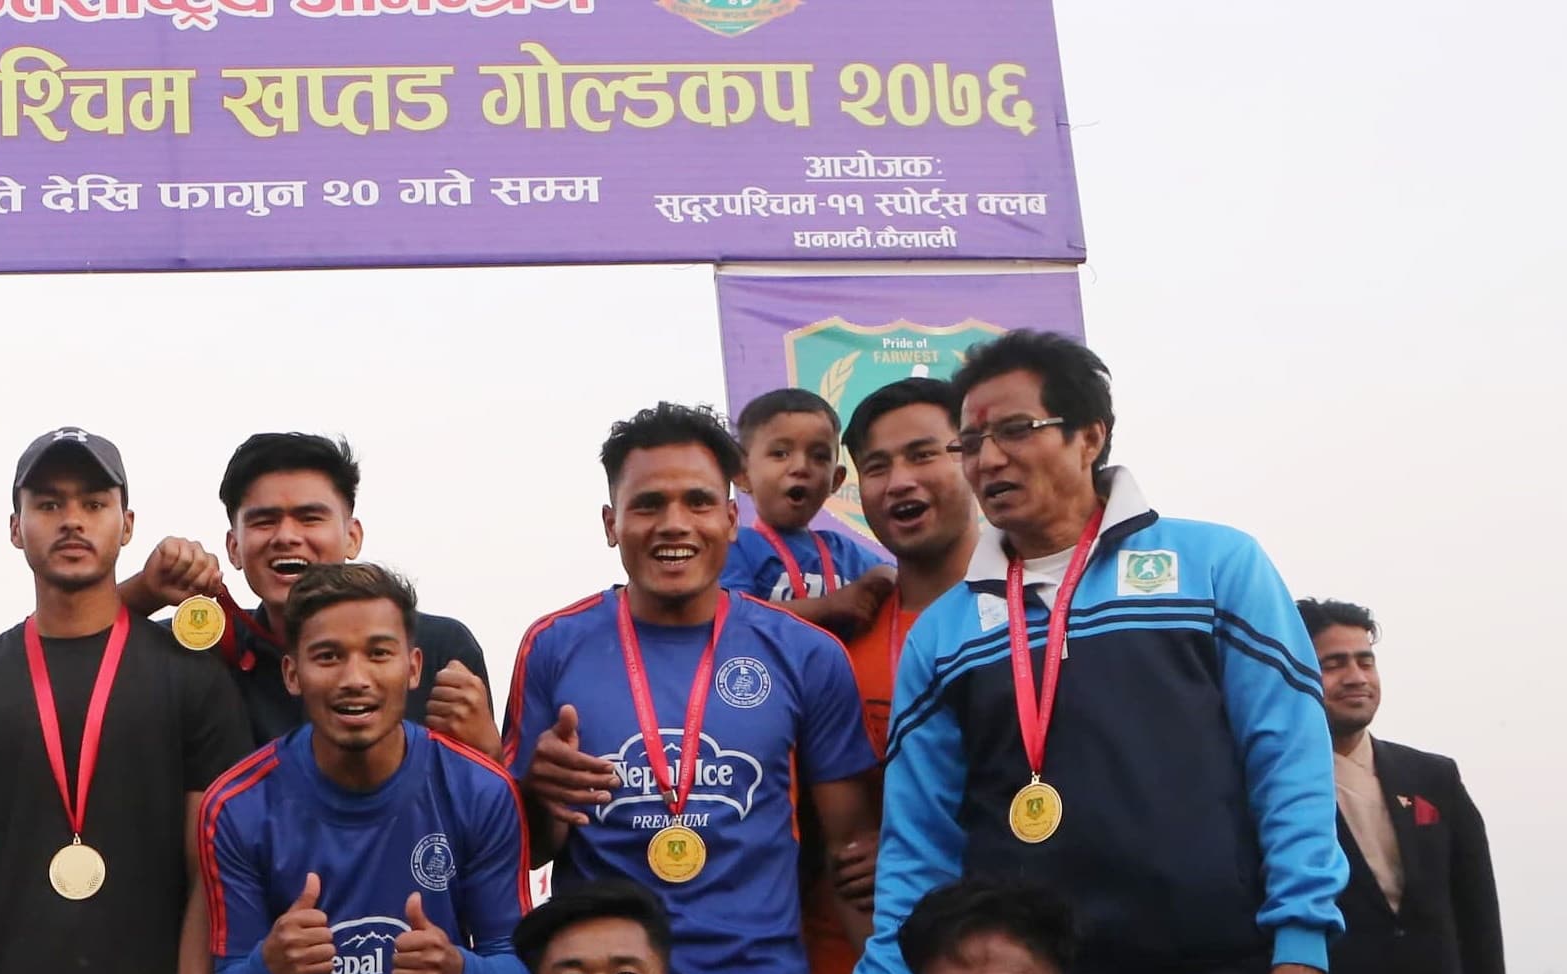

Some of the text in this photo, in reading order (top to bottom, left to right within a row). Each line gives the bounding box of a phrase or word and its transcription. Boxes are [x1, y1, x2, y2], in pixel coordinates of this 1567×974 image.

[221, 65, 455, 138] खप्तड
[478, 41, 814, 133] गोल्डकप
[838, 62, 1036, 136] २०७६
[41, 174, 142, 213] देखि
[157, 180, 307, 217] फागुन
[322, 179, 379, 207] २०
[398, 168, 474, 206] गते
[490, 175, 602, 205] सम्म
[874, 187, 968, 219] स्पोर्ट्स
[976, 193, 1048, 216] क्लब
[873, 350, 938, 363] FARWEST
[882, 338, 928, 349] Pride of
[695, 759, 733, 786] Ice
